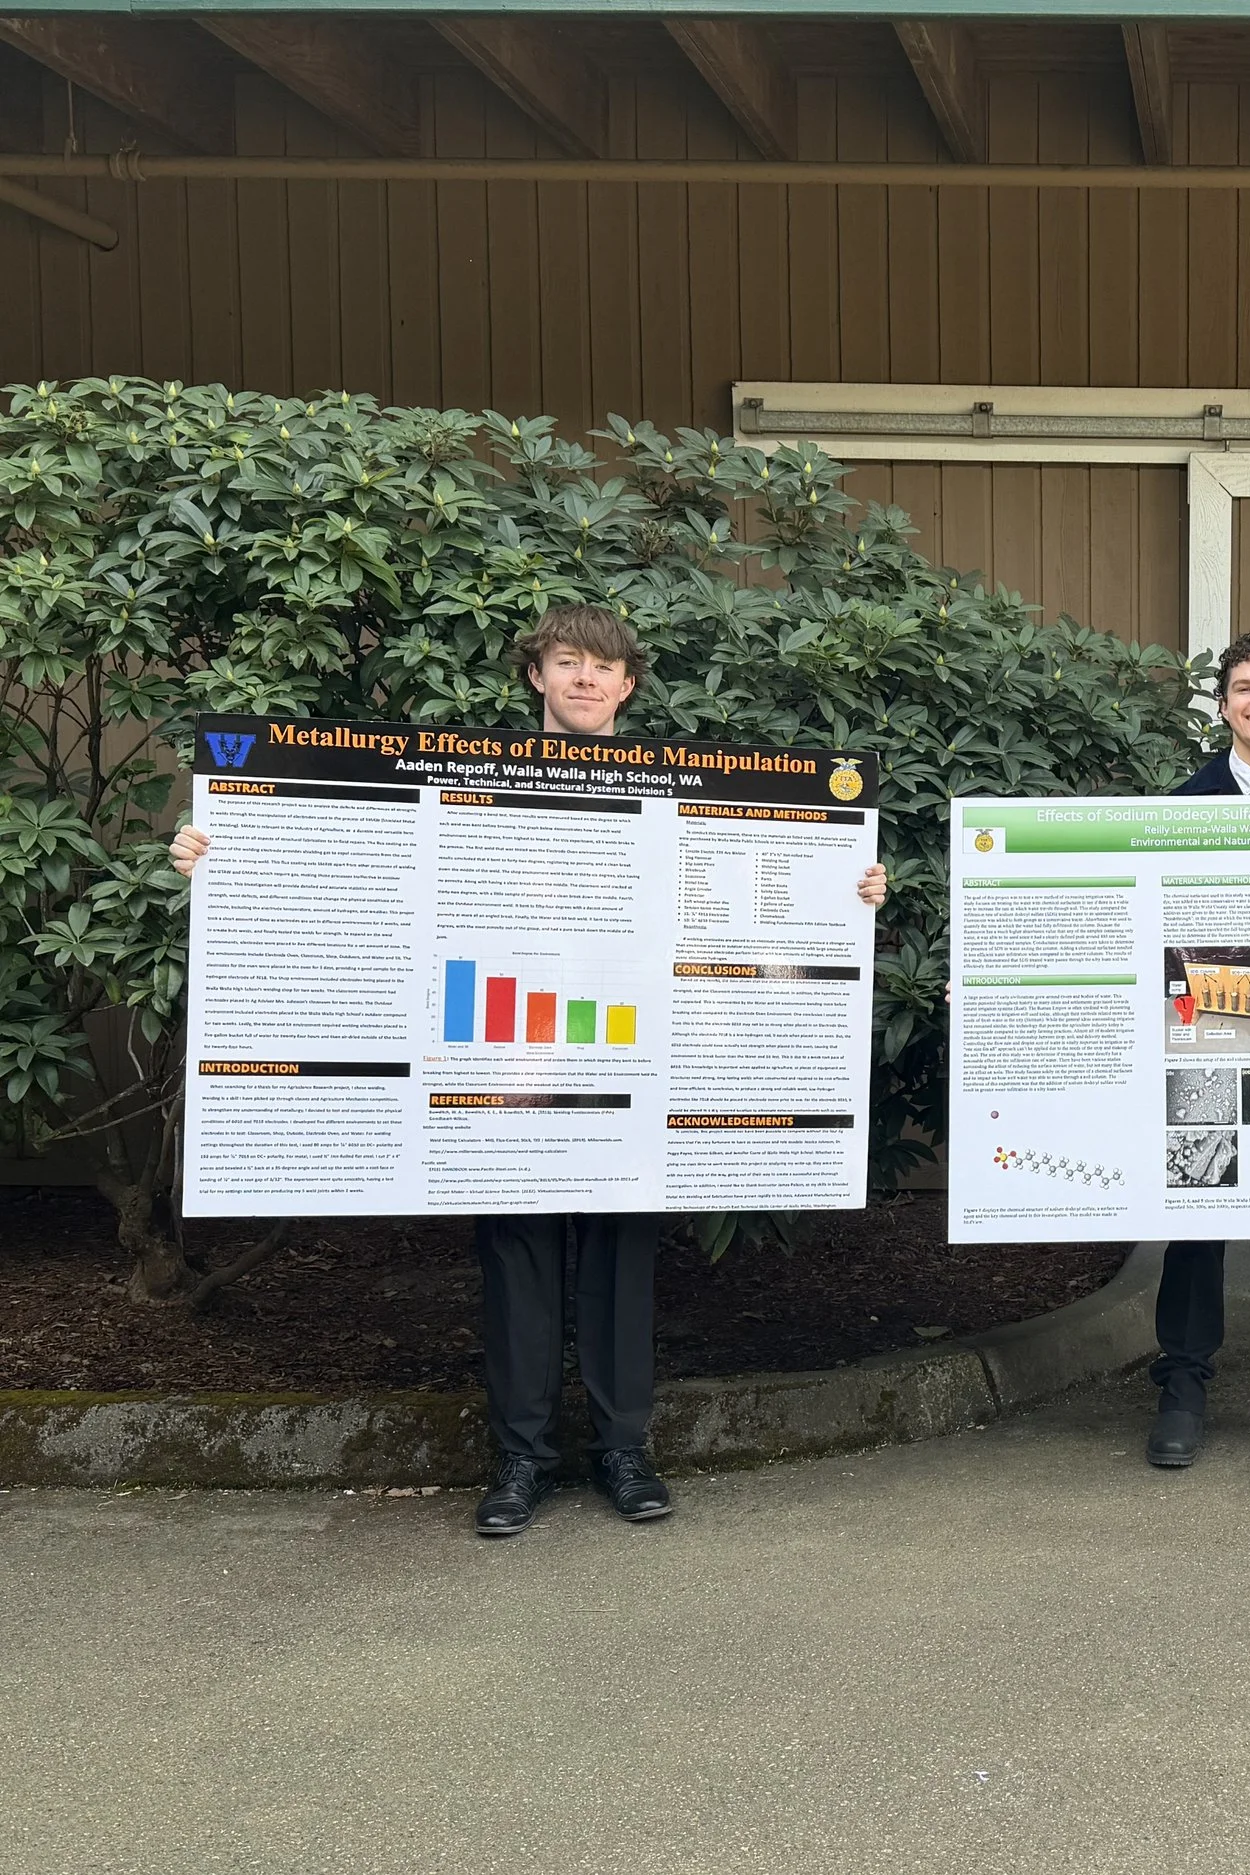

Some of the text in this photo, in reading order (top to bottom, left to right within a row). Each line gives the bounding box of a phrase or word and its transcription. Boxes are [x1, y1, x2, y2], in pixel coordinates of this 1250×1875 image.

[269, 723, 816, 774] Metallurgy Effects of Electrode Manipulation
[395, 758, 702, 788] Aaden Repoff, Walla Walla High School, WA
[210, 781, 275, 794] ABSTRACT
[427, 776, 673, 796] Power, Technical, and Structural Systems Division 5
[441, 792, 493, 804] RESULTS
[679, 805, 827, 821] MATERIALS AND METHODS
[1037, 809, 1083, 822] Effects
[1087, 808, 1102, 821] of
[1105, 808, 1157, 821] Sodium
[1162, 807, 1217, 823] Dodecyl
[1144, 824, 1169, 836] Reilly
[1172, 824, 1236, 834] Lemma-Walla
[1130, 836, 1200, 846] Environmental
[1202, 836, 1220, 845] and
[675, 965, 757, 976] CONCLUSIONS
[200, 1063, 299, 1074] INTRODUCTION
[431, 1095, 504, 1105] REFERENCES
[668, 1116, 793, 1127] ACKNOWLEDGEMENTS
